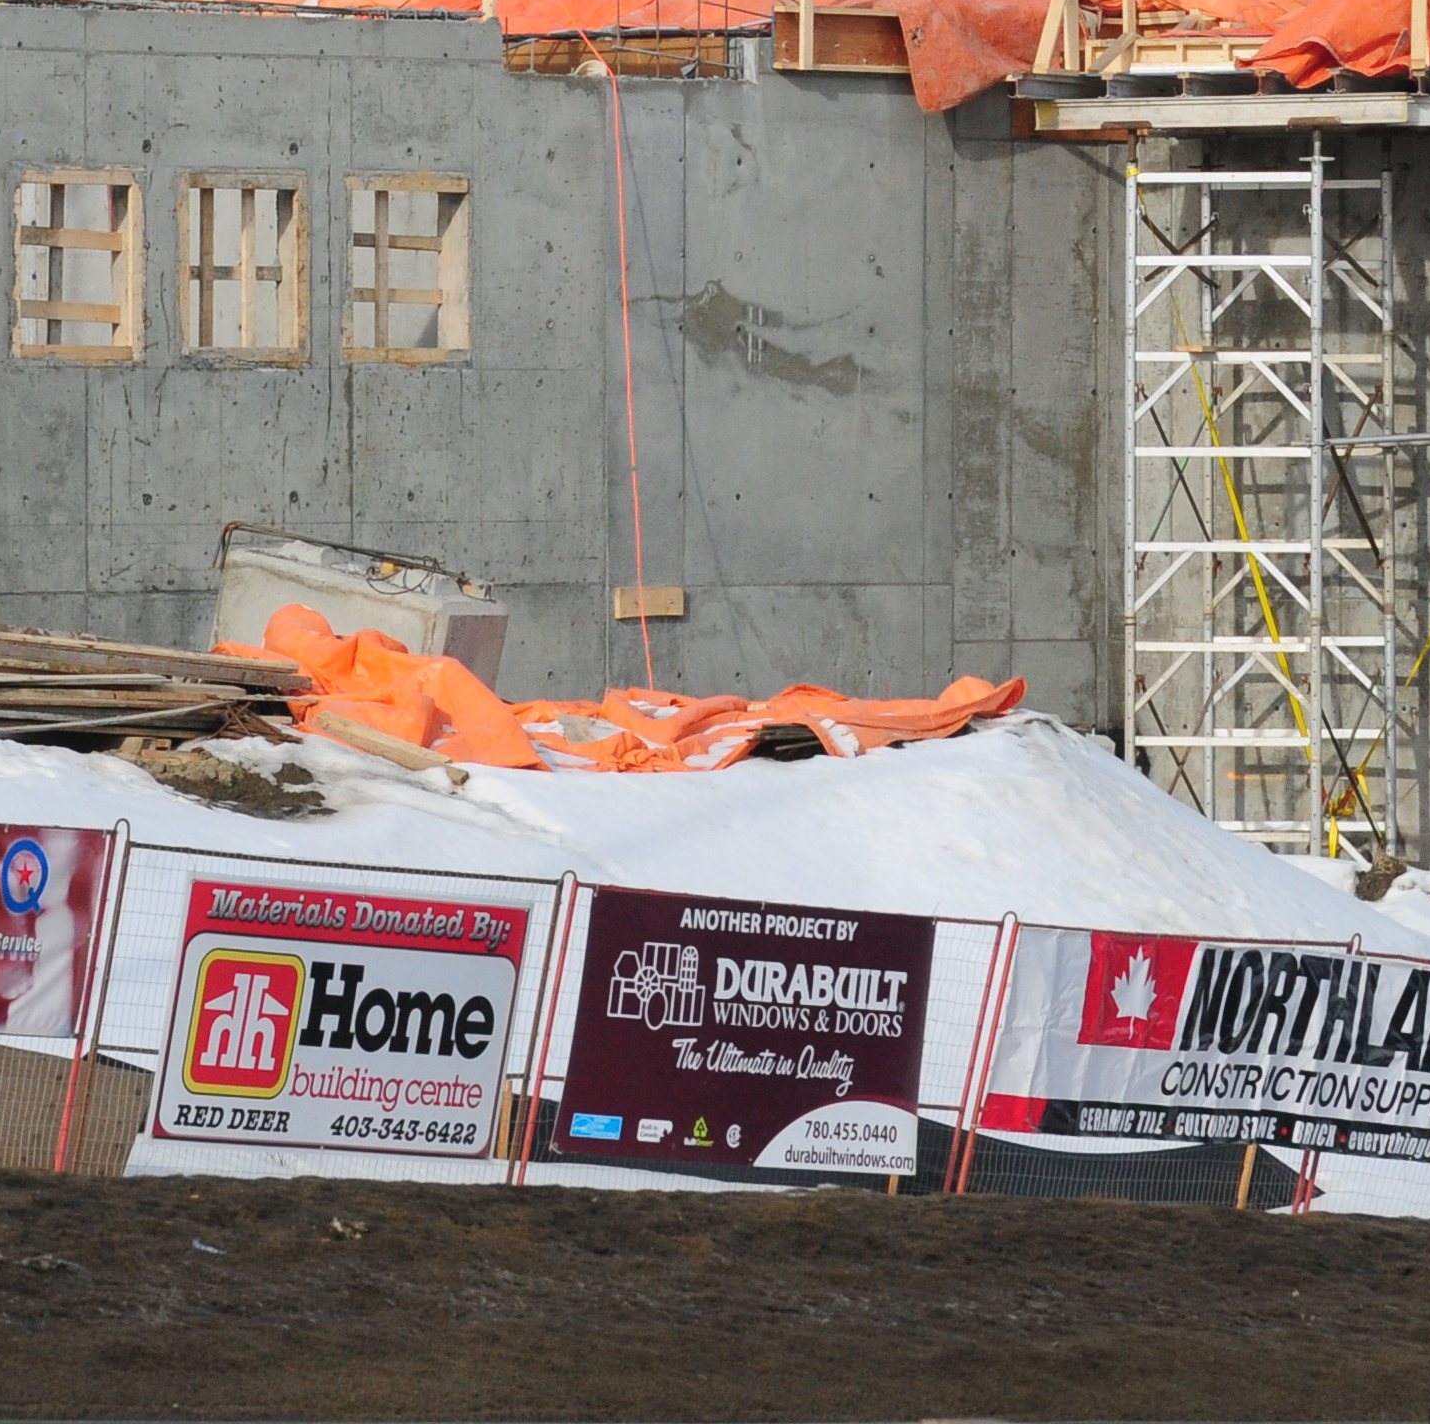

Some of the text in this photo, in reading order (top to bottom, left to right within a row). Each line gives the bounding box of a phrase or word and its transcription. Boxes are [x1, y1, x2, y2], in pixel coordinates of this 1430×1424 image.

[207, 888, 513, 951] Materials Donated By:
[679, 908, 859, 942] ANOTHER PROJECT BY
[298, 961, 496, 1060] Home
[712, 1001, 904, 1038] WINDOWS & DOORS
[288, 1062, 483, 1112] building centre
[672, 1038, 704, 1070] The
[706, 1040, 775, 1076] Ultimate
[795, 1045, 855, 1098] Quality
[1161, 1062, 1358, 1108] CONSTRUCTION
[173, 1104, 291, 1133] RED DEER
[329, 1114, 478, 1146] 403-343-6422
[803, 1119, 898, 1145] 780.455.0440
[1079, 1108, 1135, 1131] CERAMIC
[1136, 1113, 1165, 1135] TILE
[1174, 1115, 1240, 1140] CULTURED
[1292, 1122, 1335, 1148] BRICK
[783, 1144, 915, 1173] durabuiltwindows.com
